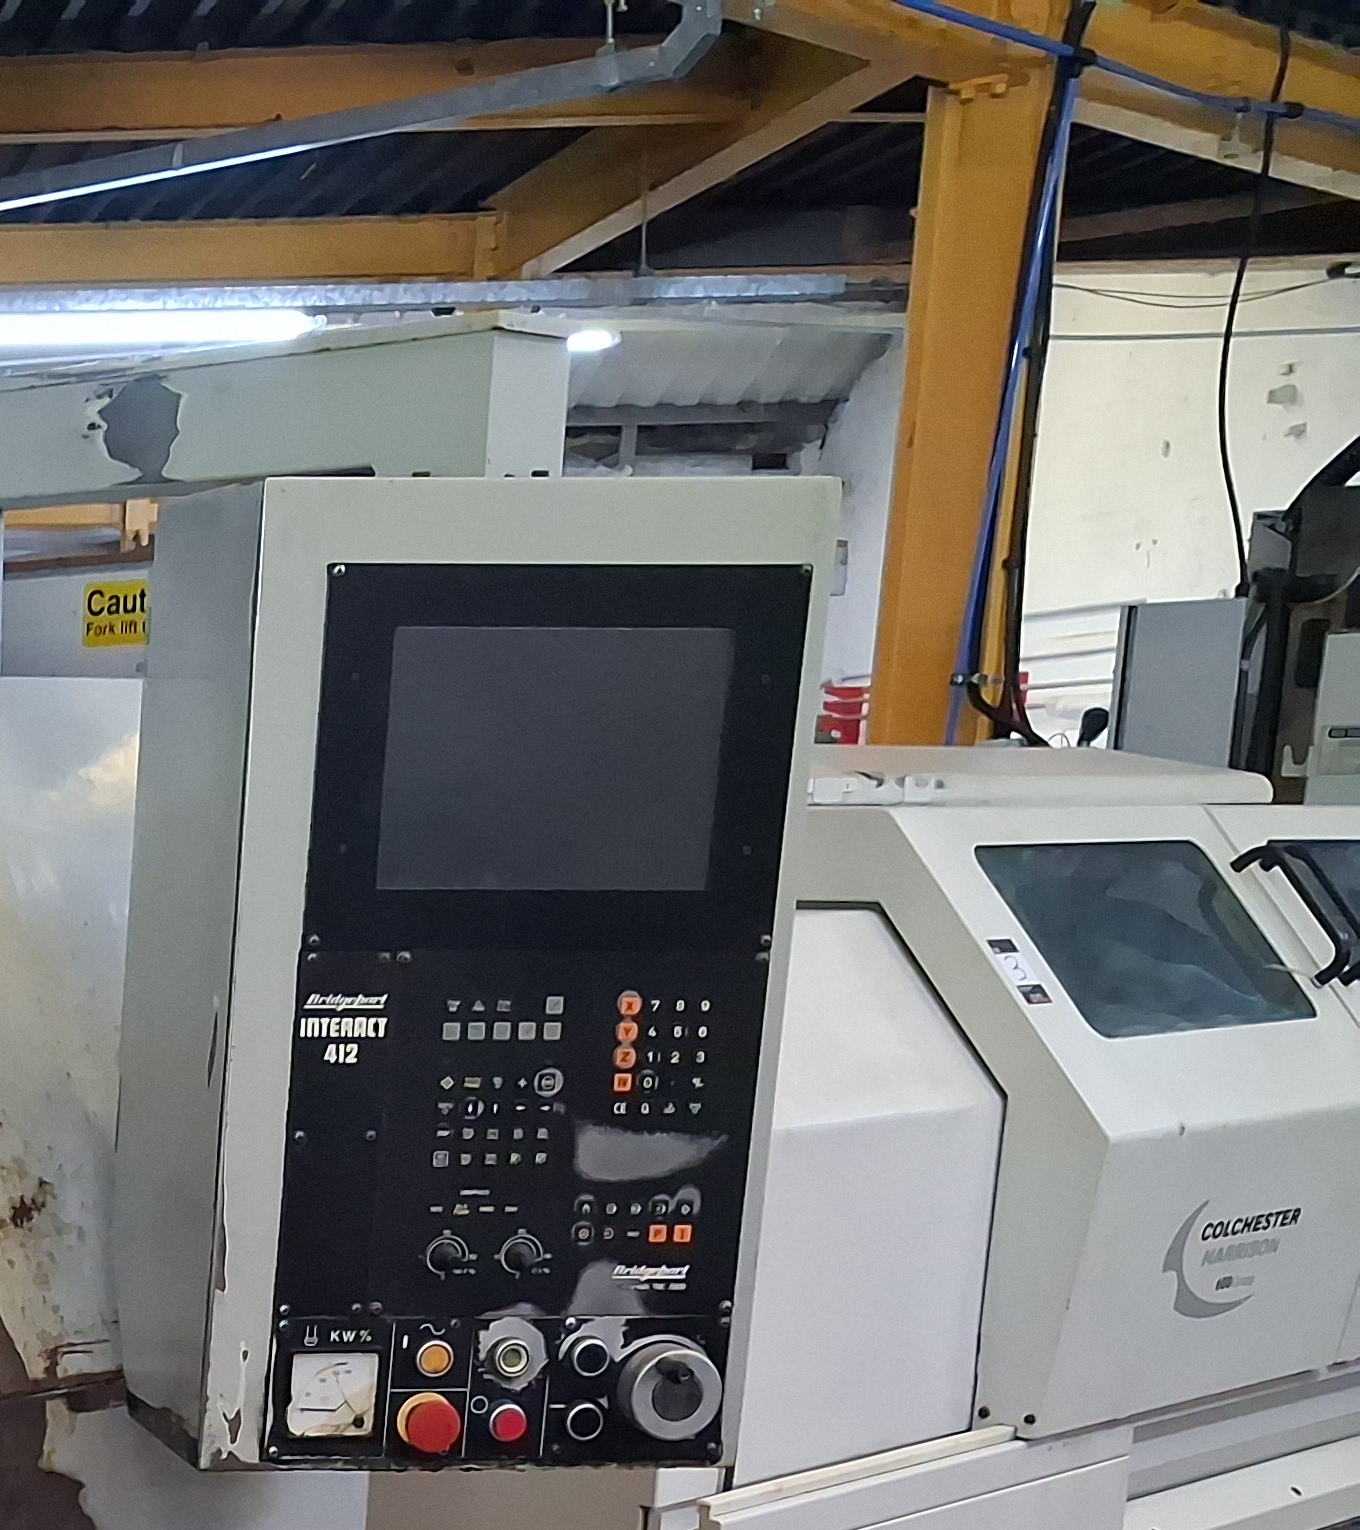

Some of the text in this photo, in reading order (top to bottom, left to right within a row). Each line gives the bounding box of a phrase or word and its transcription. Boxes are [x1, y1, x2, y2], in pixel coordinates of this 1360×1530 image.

[86, 622, 115, 636] Fork
[650, 999, 660, 1011] 7
[299, 1017, 388, 1038] INTERACT
[323, 1043, 359, 1064] 412
[670, 1051, 680, 1064] 2
[1201, 1207, 1302, 1241] COLCHESTER
[330, 1330, 356, 1343] KW
